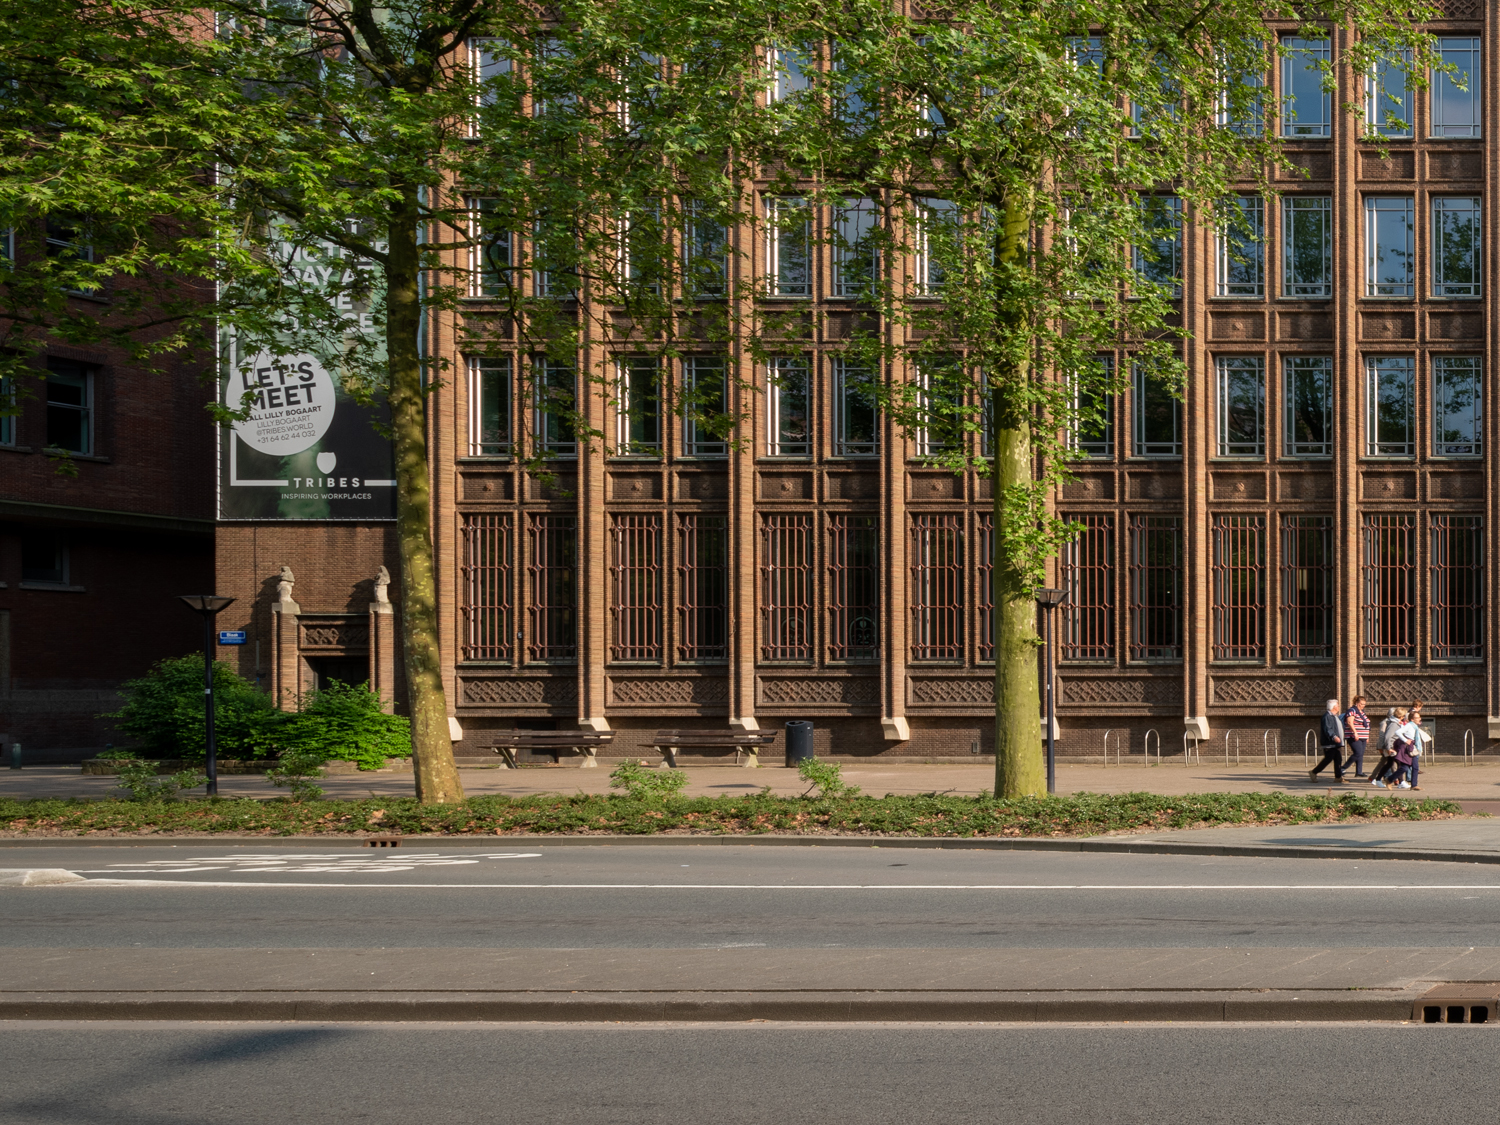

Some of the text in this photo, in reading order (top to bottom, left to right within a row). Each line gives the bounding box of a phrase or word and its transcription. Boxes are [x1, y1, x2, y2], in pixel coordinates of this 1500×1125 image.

[280, 265, 333, 286] DAY
[241, 361, 315, 391] LET'S
[245, 382, 317, 412] MEET
[265, 410, 284, 420] LILLY
[285, 405, 322, 417] BOGAART
[257, 436, 269, 444] +31
[270, 435, 280, 443] 64
[281, 433, 290, 441] 62
[302, 429, 316, 438] 032
[293, 477, 360, 489] TRIBES
